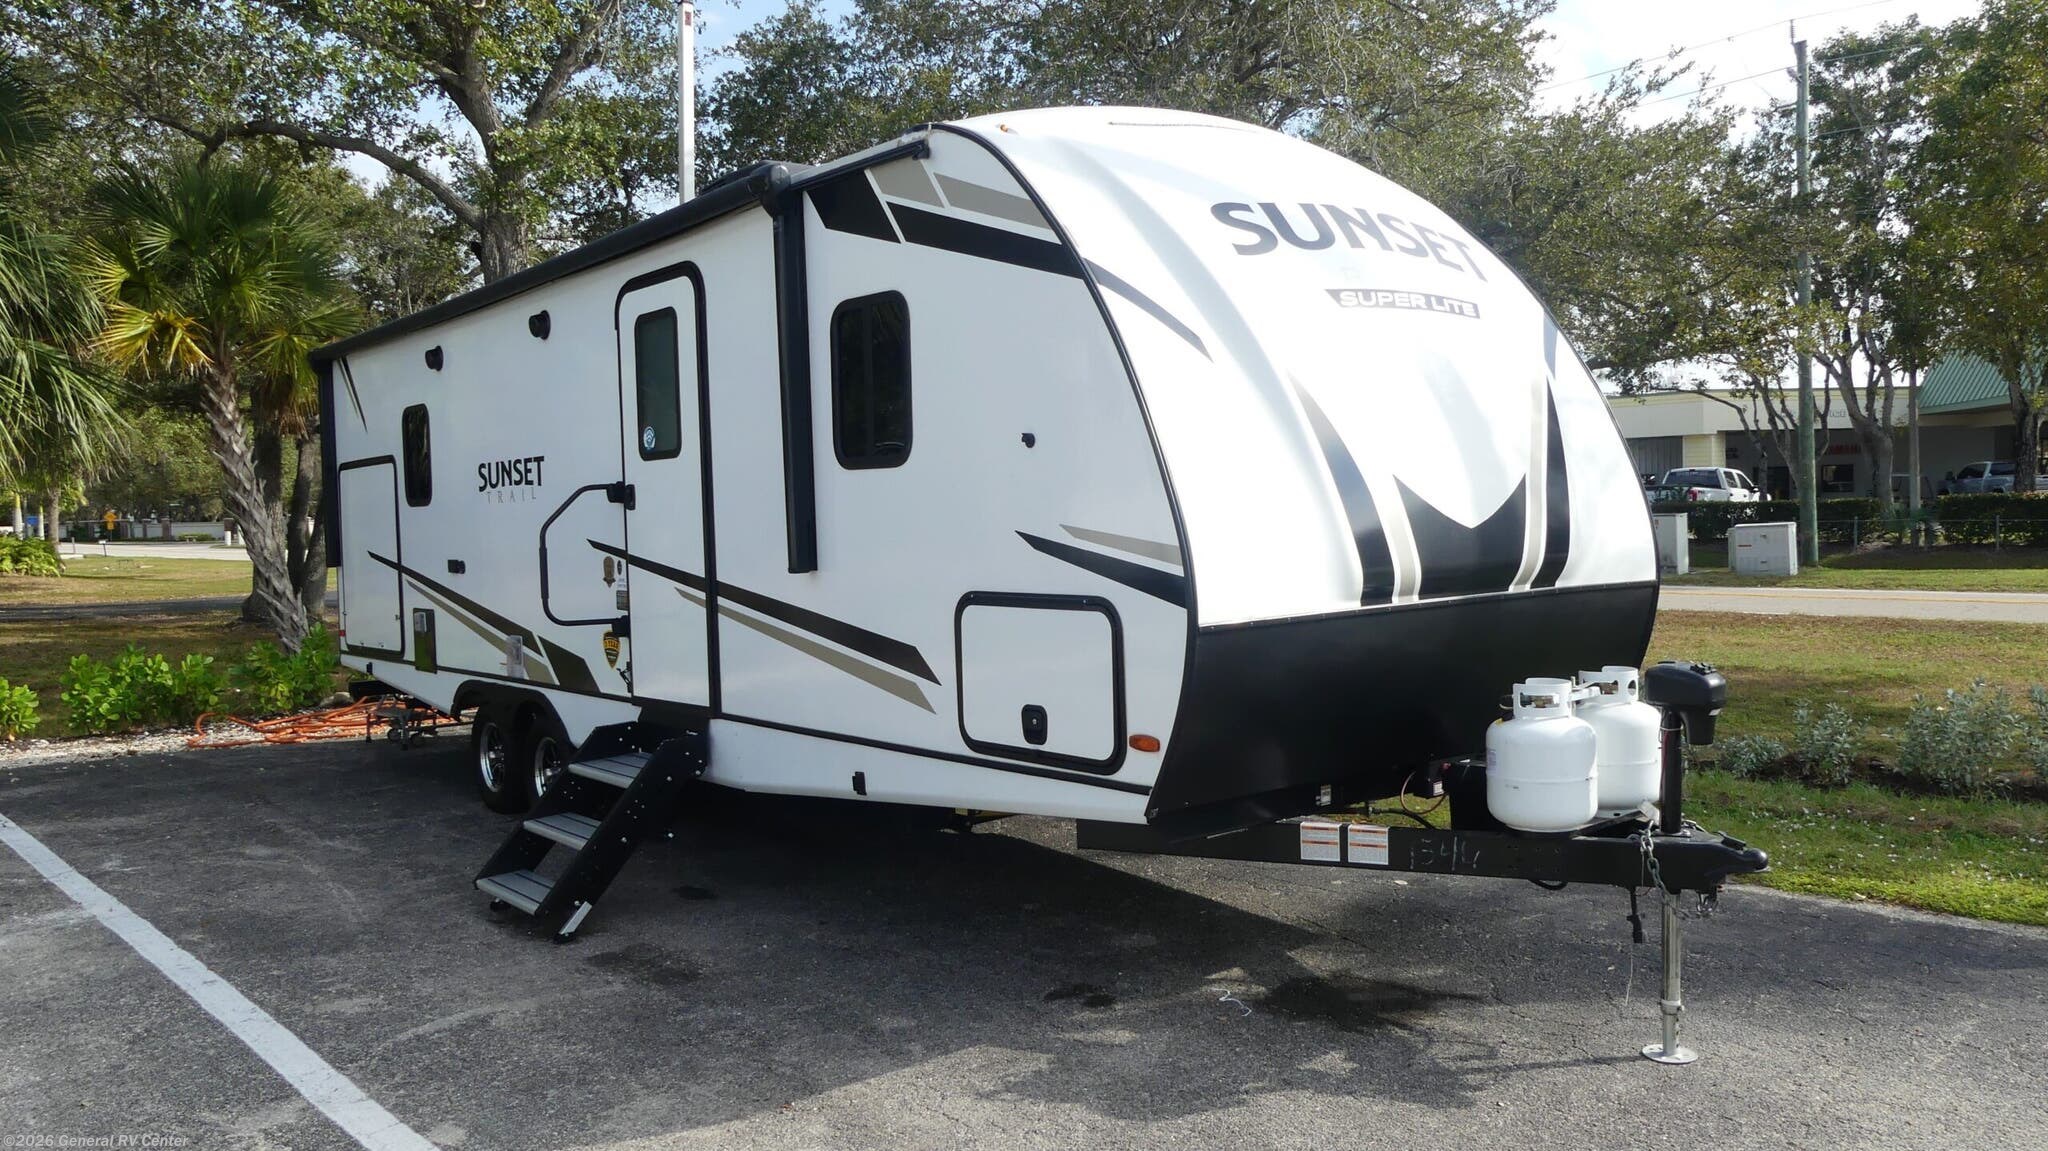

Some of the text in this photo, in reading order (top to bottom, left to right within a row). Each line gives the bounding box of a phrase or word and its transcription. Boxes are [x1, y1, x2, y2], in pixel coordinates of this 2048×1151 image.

[1210, 202, 1488, 282] SUNSET
[1339, 290, 1477, 316] SUPER LITE
[478, 456, 544, 492] SUNSET
[486, 487, 537, 504] TRAIL
